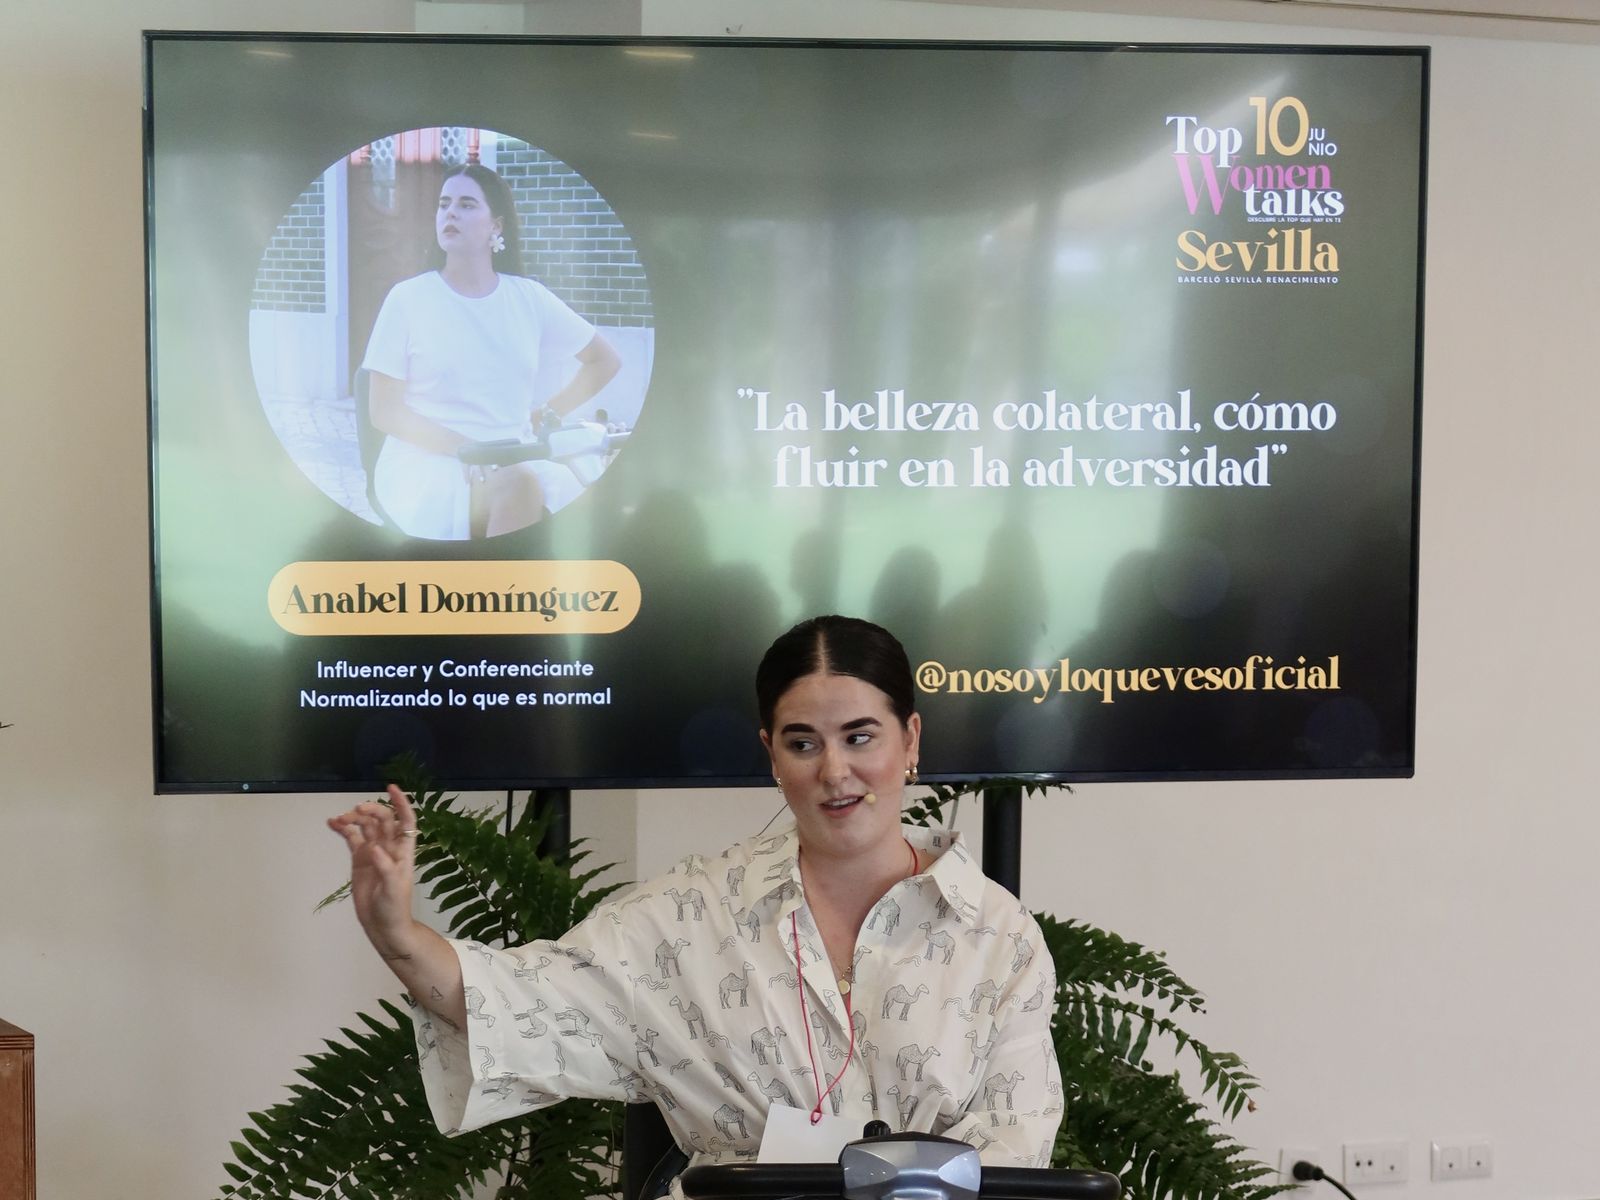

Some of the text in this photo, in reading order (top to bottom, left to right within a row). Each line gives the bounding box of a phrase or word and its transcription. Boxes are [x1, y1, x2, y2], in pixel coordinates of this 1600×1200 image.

[1166, 116, 1242, 168] Top
[1249, 96, 1309, 156] 10
[1308, 128, 1326, 141] JU
[1308, 143, 1337, 156] NIO
[1172, 154, 1332, 216] Women
[1243, 183, 1345, 217] talks
[1175, 227, 1340, 272] Sevilla
[1177, 275, 1339, 284] BARCELÓ SEVILLA RENACIMIENTO
[821, 388, 980, 432] belleza
[992, 388, 1202, 433] colateral,
[1213, 392, 1337, 431] cómo
[772, 444, 888, 488] fluir
[899, 458, 958, 487] en
[969, 445, 1010, 487] la
[281, 582, 620, 622] Anabel Domínguez
[316, 659, 594, 682] Influencer y Conferenciante
[914, 654, 1342, 705] @nosoyloquevesoficial
[299, 687, 612, 711] Normalizando lo que es normal
